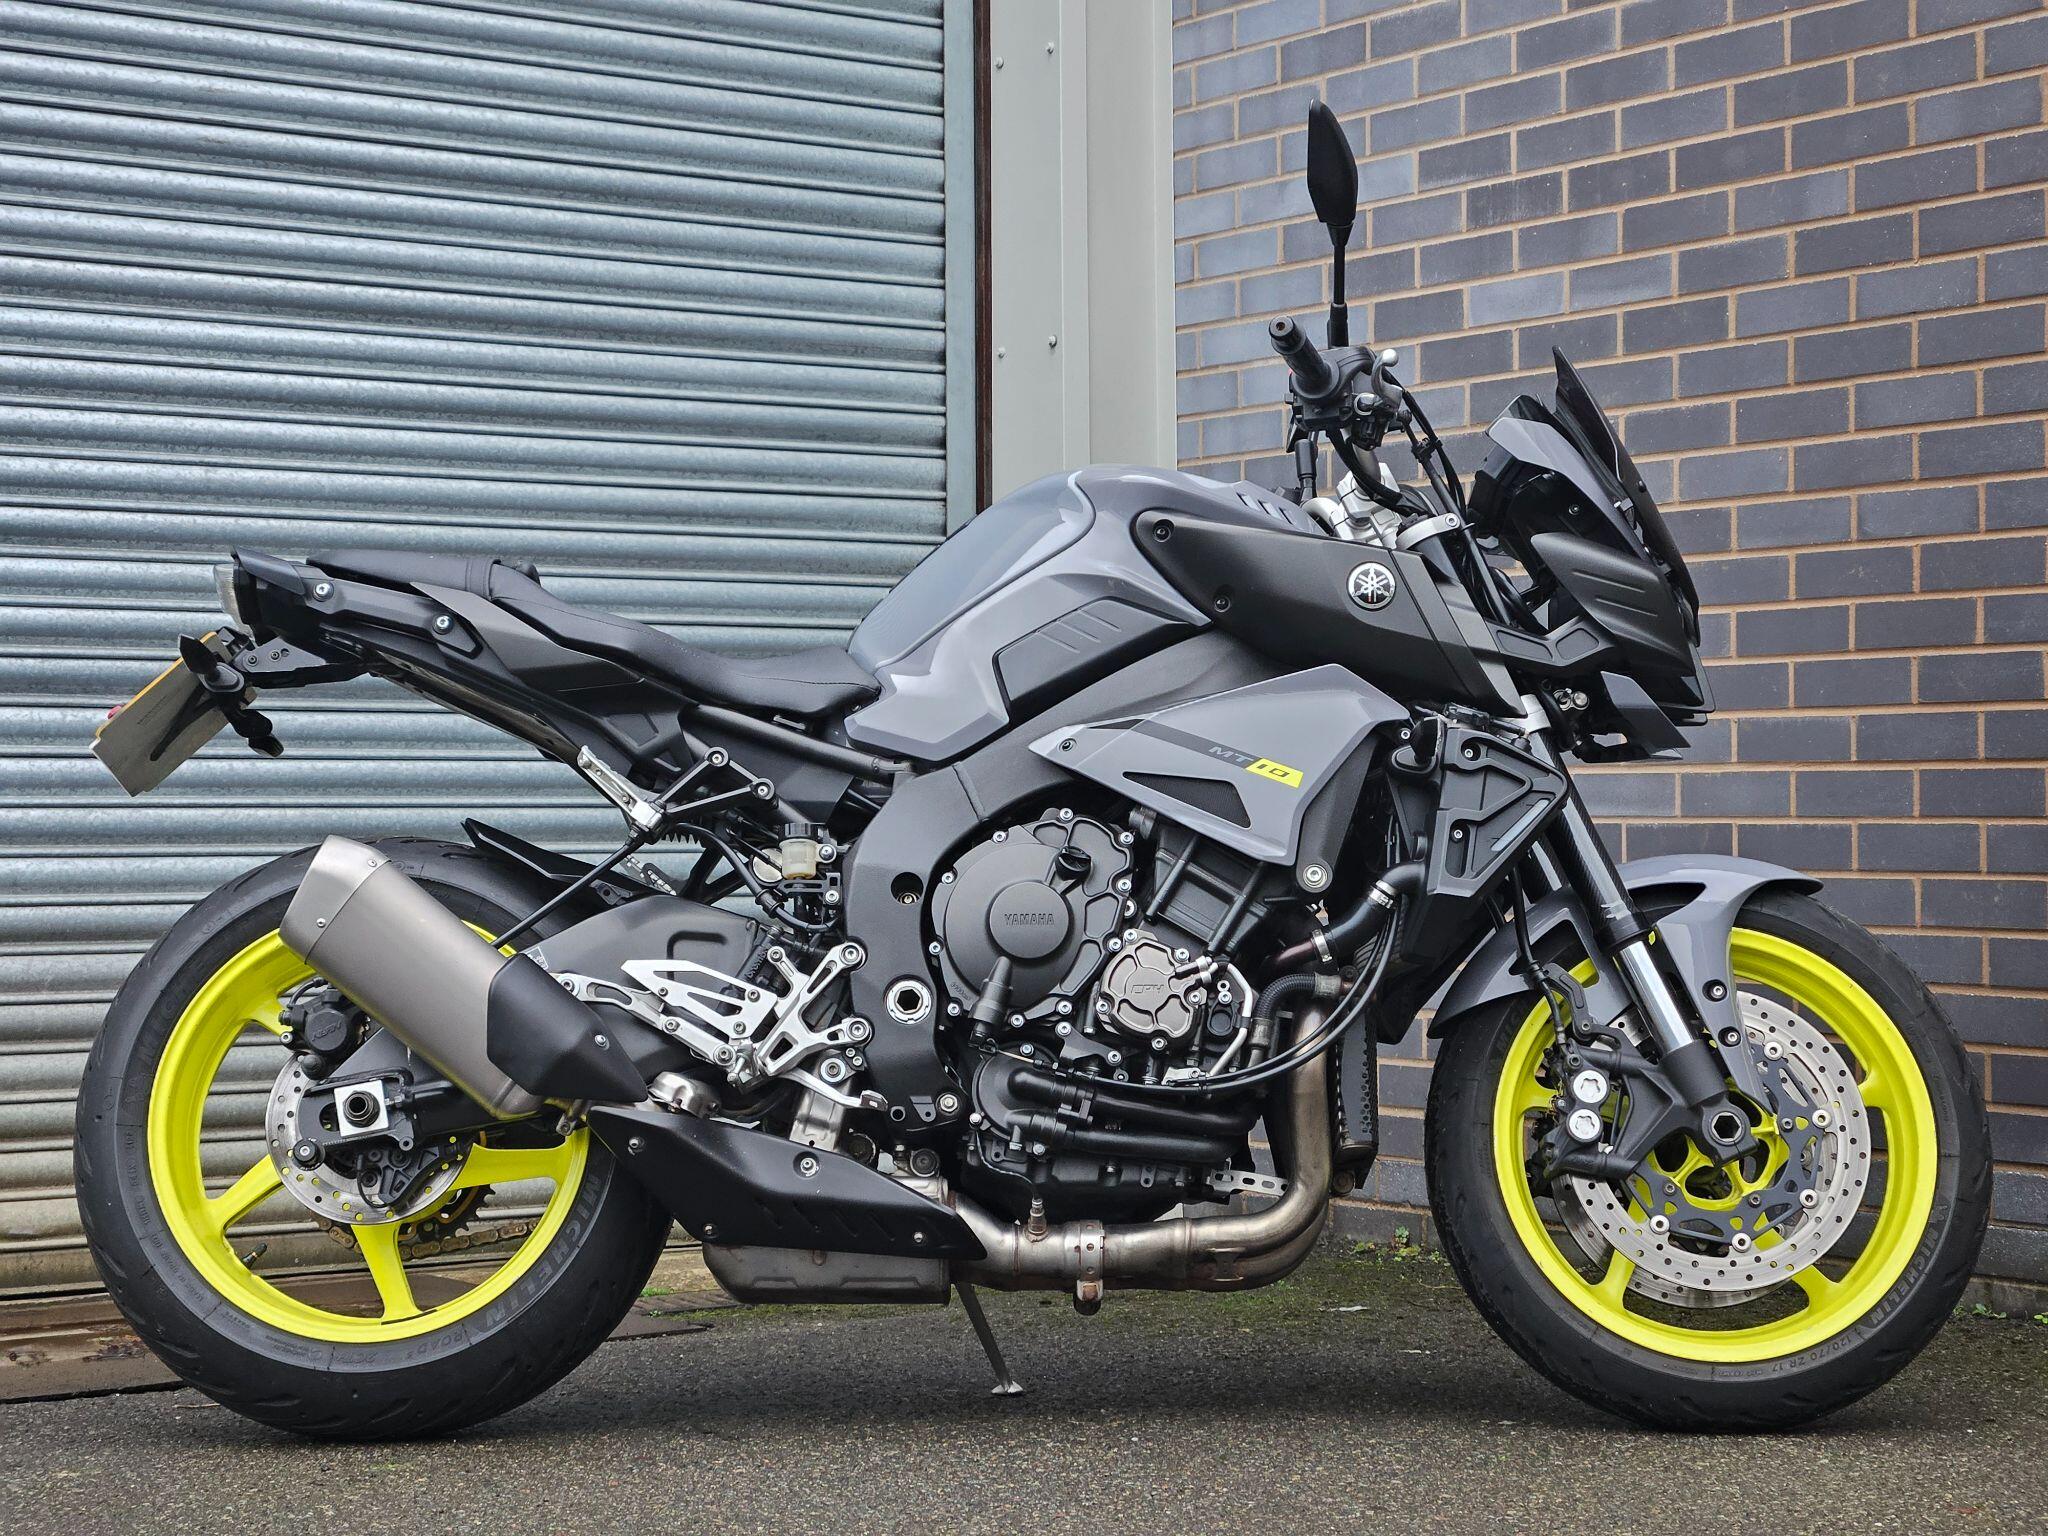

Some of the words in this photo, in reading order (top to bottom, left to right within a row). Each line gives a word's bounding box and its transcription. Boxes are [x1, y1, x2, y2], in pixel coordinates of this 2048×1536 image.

[1209, 746, 1254, 763] MT
[1256, 763, 1290, 778] 10
[1004, 912, 1055, 926] YAMAHA
[479, 1173, 604, 1327] MICHELIN
[1866, 1225, 1941, 1326] MICHELIN
[415, 1329, 464, 1354] ROAD
[1809, 1335, 1852, 1361] 120/70
[1771, 1361, 1784, 1372] 17
[1787, 1355, 1806, 1368] ZR
